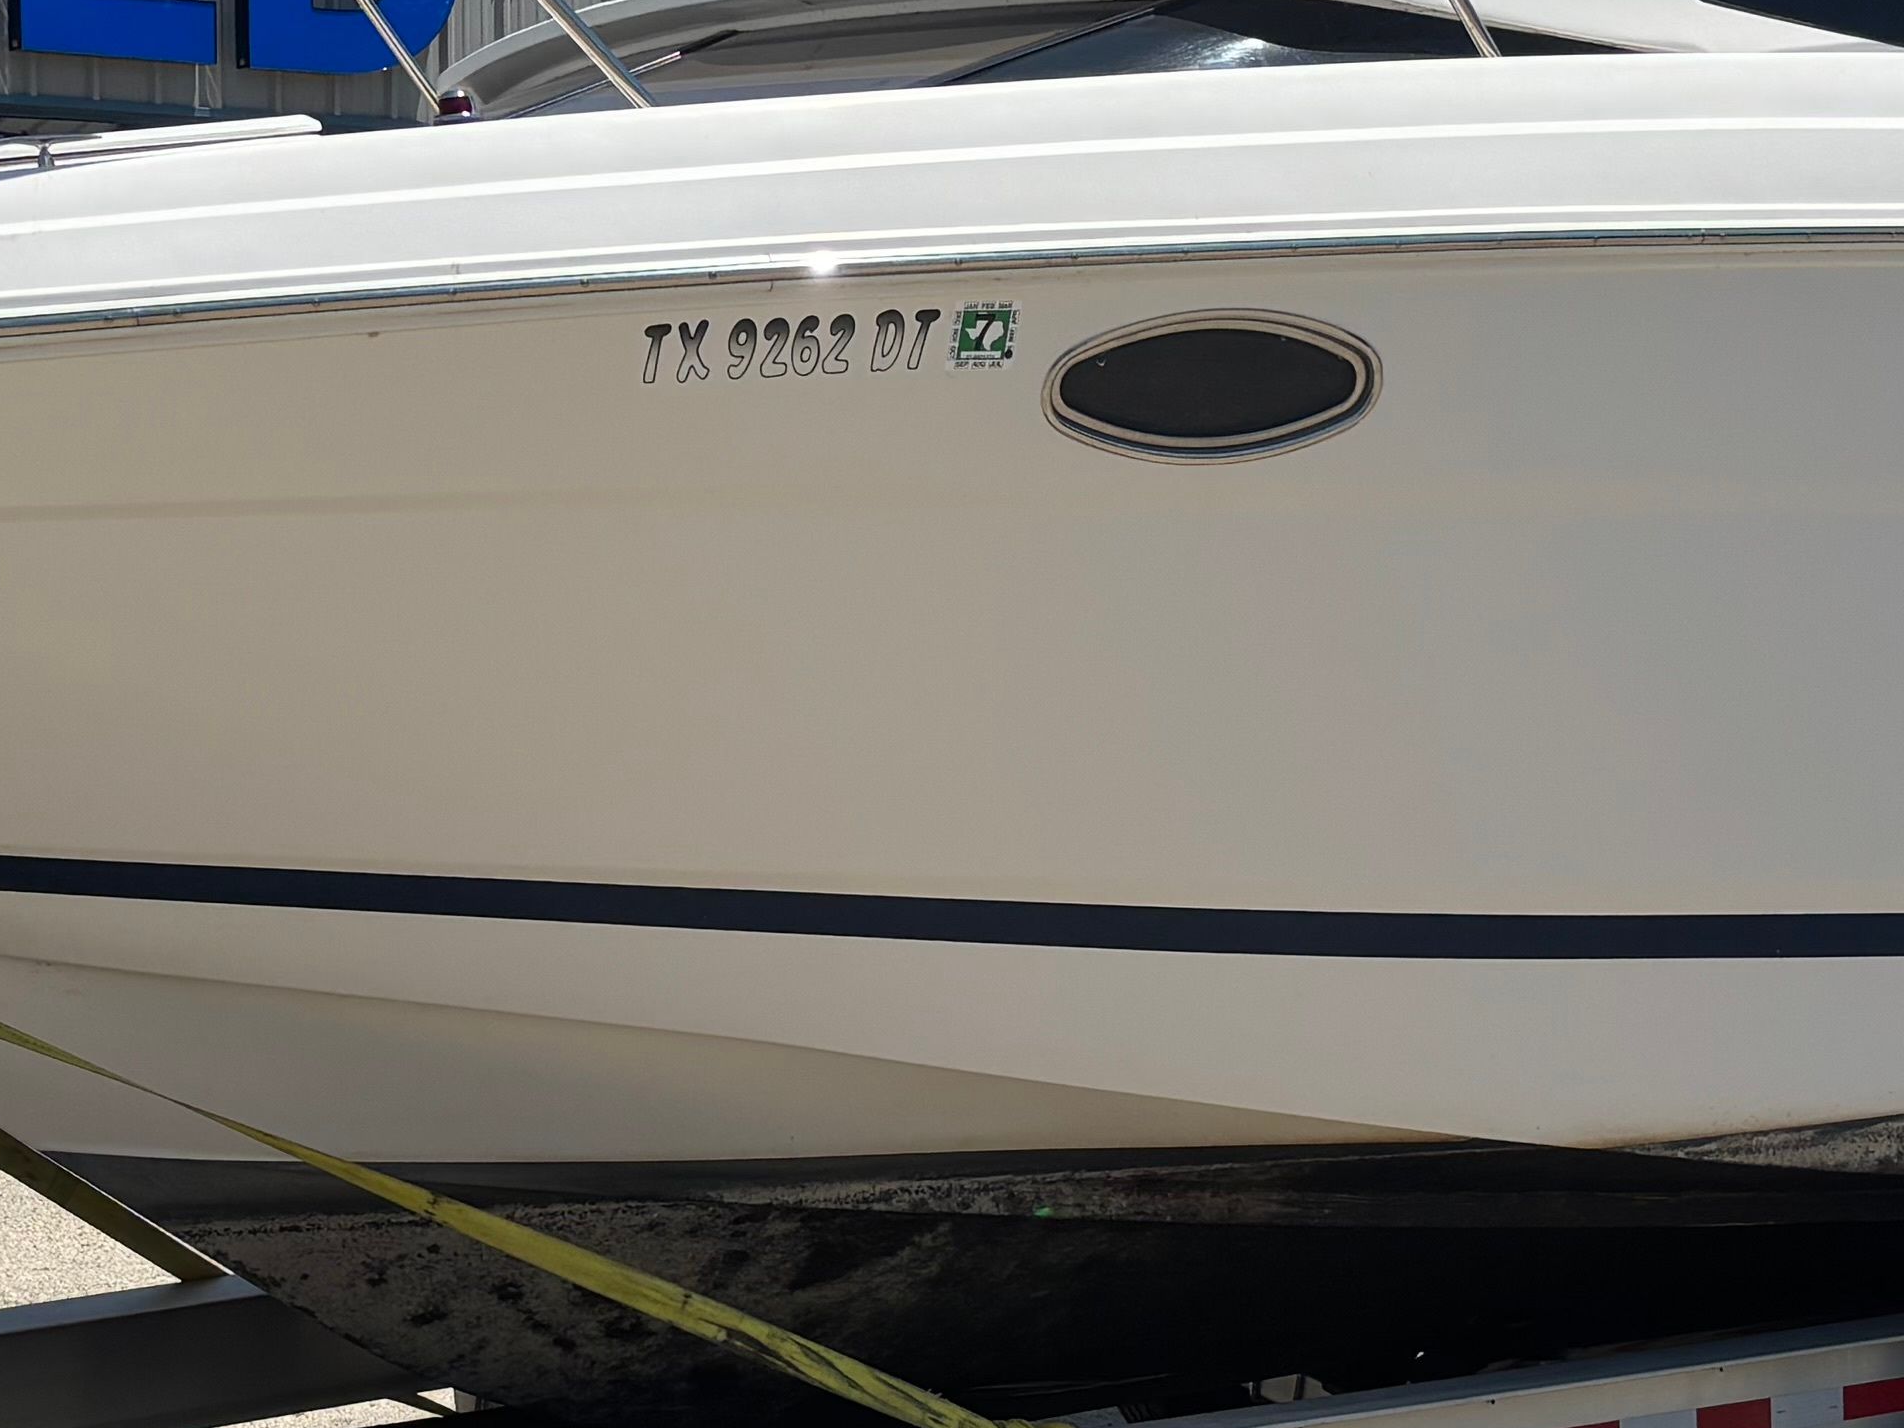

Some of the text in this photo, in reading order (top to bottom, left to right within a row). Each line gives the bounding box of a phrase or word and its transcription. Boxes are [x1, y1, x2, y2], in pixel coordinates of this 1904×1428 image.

[643, 319, 710, 384] TX
[727, 314, 856, 379] 9262
[870, 308, 941, 372] DT
